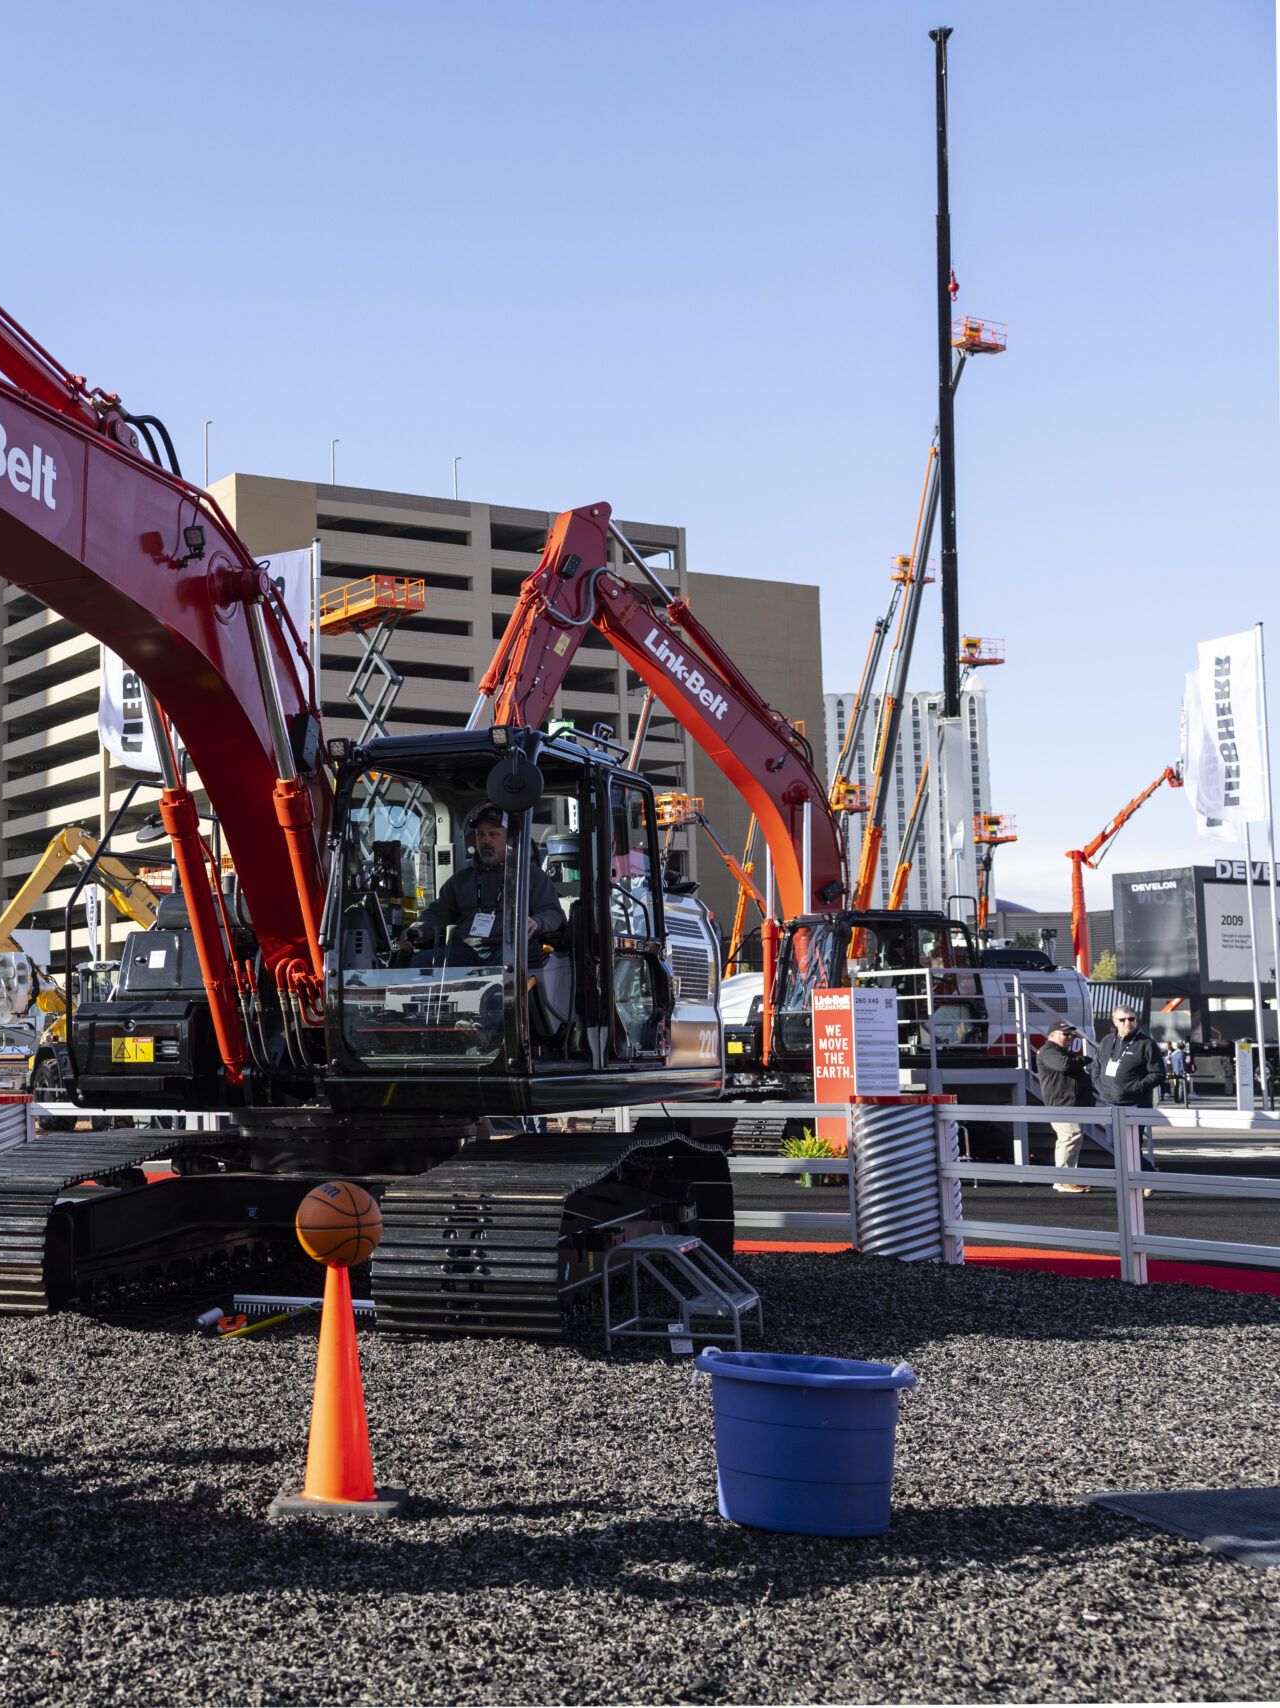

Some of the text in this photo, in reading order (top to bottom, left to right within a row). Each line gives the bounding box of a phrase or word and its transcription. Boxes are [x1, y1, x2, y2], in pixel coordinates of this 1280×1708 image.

[644, 628, 729, 721] Link-Belt
[1131, 881, 1177, 892] DEVELON
[1221, 914, 1243, 926] 2009
[825, 1024, 841, 1036] WE
[699, 1030, 718, 1058] 220
[819, 1038, 848, 1050] MOVE
[824, 1052, 844, 1064] THE
[816, 1066, 853, 1078] EARTH.
